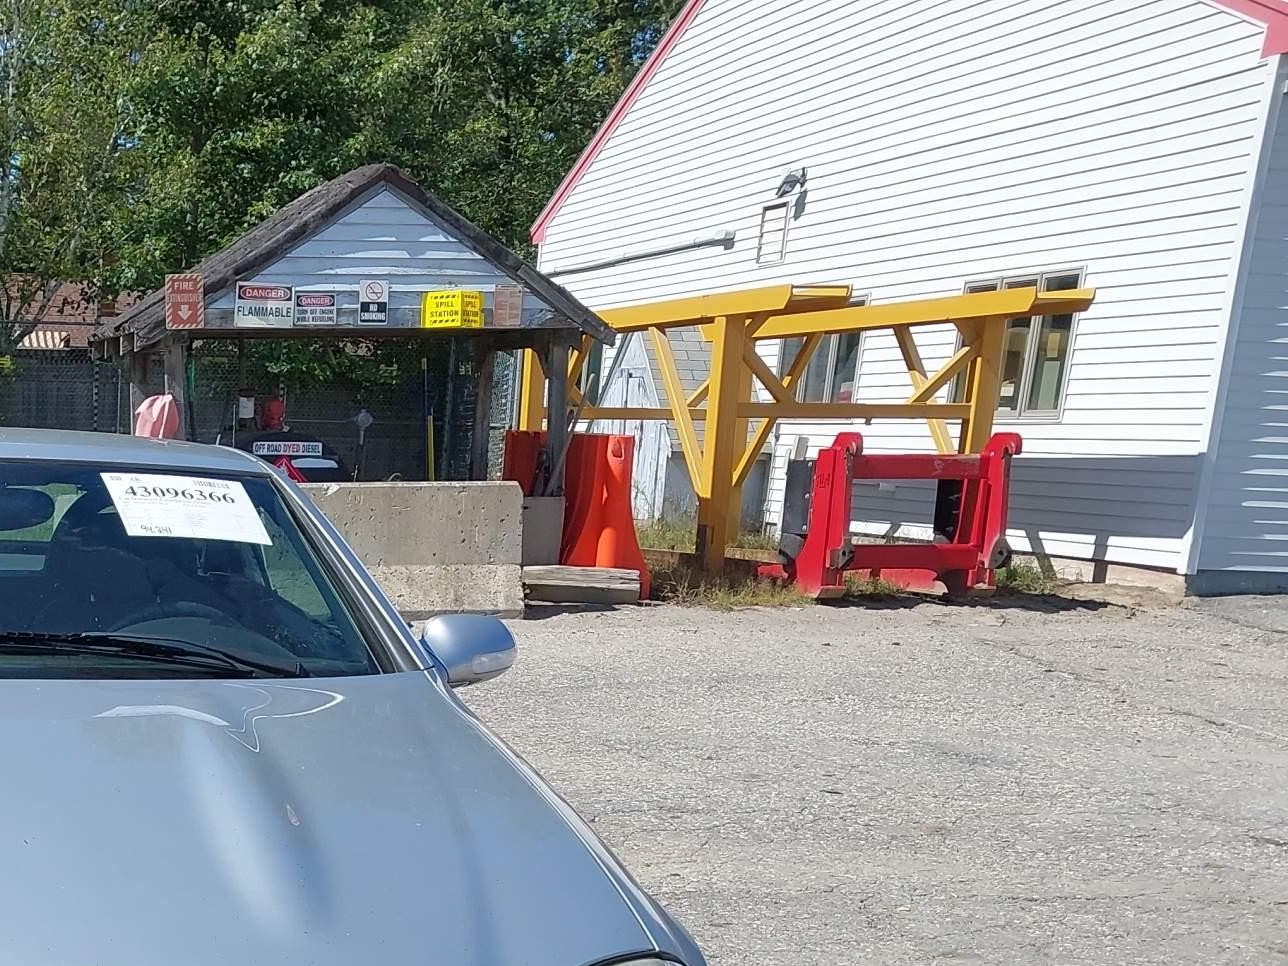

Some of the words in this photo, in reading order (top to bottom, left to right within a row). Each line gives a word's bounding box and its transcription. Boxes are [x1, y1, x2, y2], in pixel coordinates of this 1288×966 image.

[174, 281, 194, 290] FIRE
[245, 287, 285, 298] DANGER
[301, 296, 330, 305] DANGER
[435, 301, 454, 309] SPILL
[237, 305, 292, 318] FLAMMABLE
[368, 303, 378, 312] NO
[360, 311, 386, 321] SMOKING
[430, 309, 459, 318] STATION
[254, 443, 266, 454] OFF
[266, 443, 282, 454] ROAD
[283, 443, 301, 454] DYED
[301, 443, 321, 455] DIESEL
[124, 485, 236, 504] 43096366
